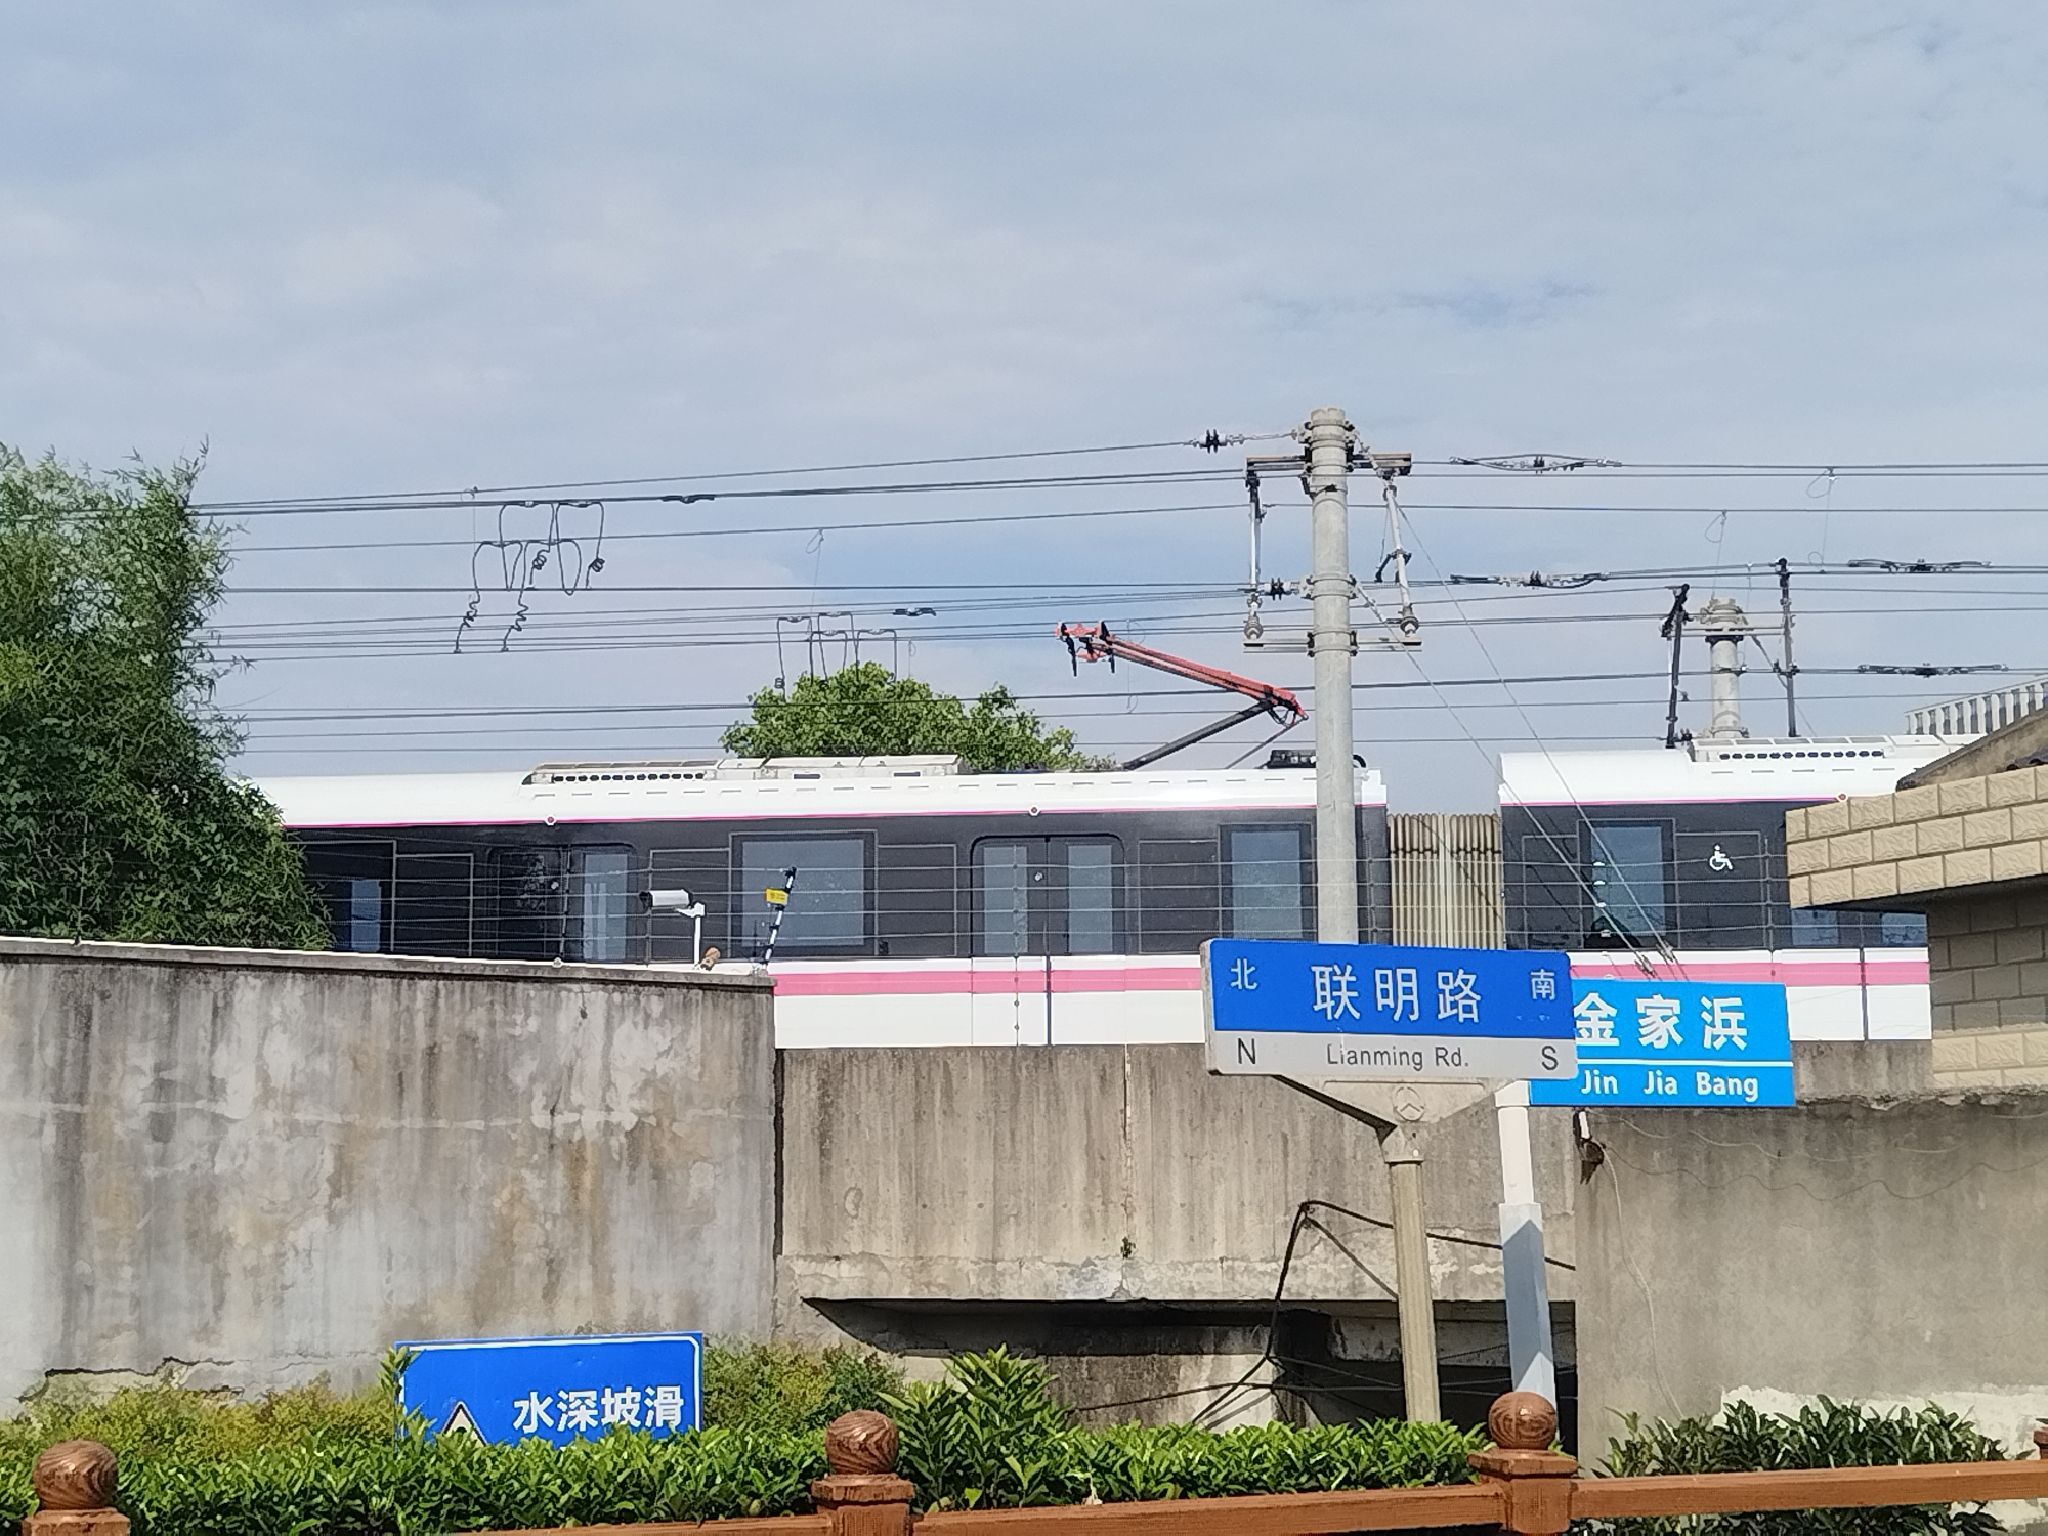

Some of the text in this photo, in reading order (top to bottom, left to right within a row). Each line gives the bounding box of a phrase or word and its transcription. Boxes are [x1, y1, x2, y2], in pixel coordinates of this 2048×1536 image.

[1230, 957, 1258, 990] 北
[1529, 968, 1556, 1001] 南
[1310, 964, 1482, 1024] 联明路
[1573, 991, 1749, 1052] 金家浜
[1237, 1037, 1257, 1066] N
[1326, 1042, 1470, 1072] Lianming Rd.
[1540, 1045, 1560, 1071] S
[1580, 1069, 1759, 1103] Jin Jia Bang
[512, 1384, 685, 1435] 水深坡滑
